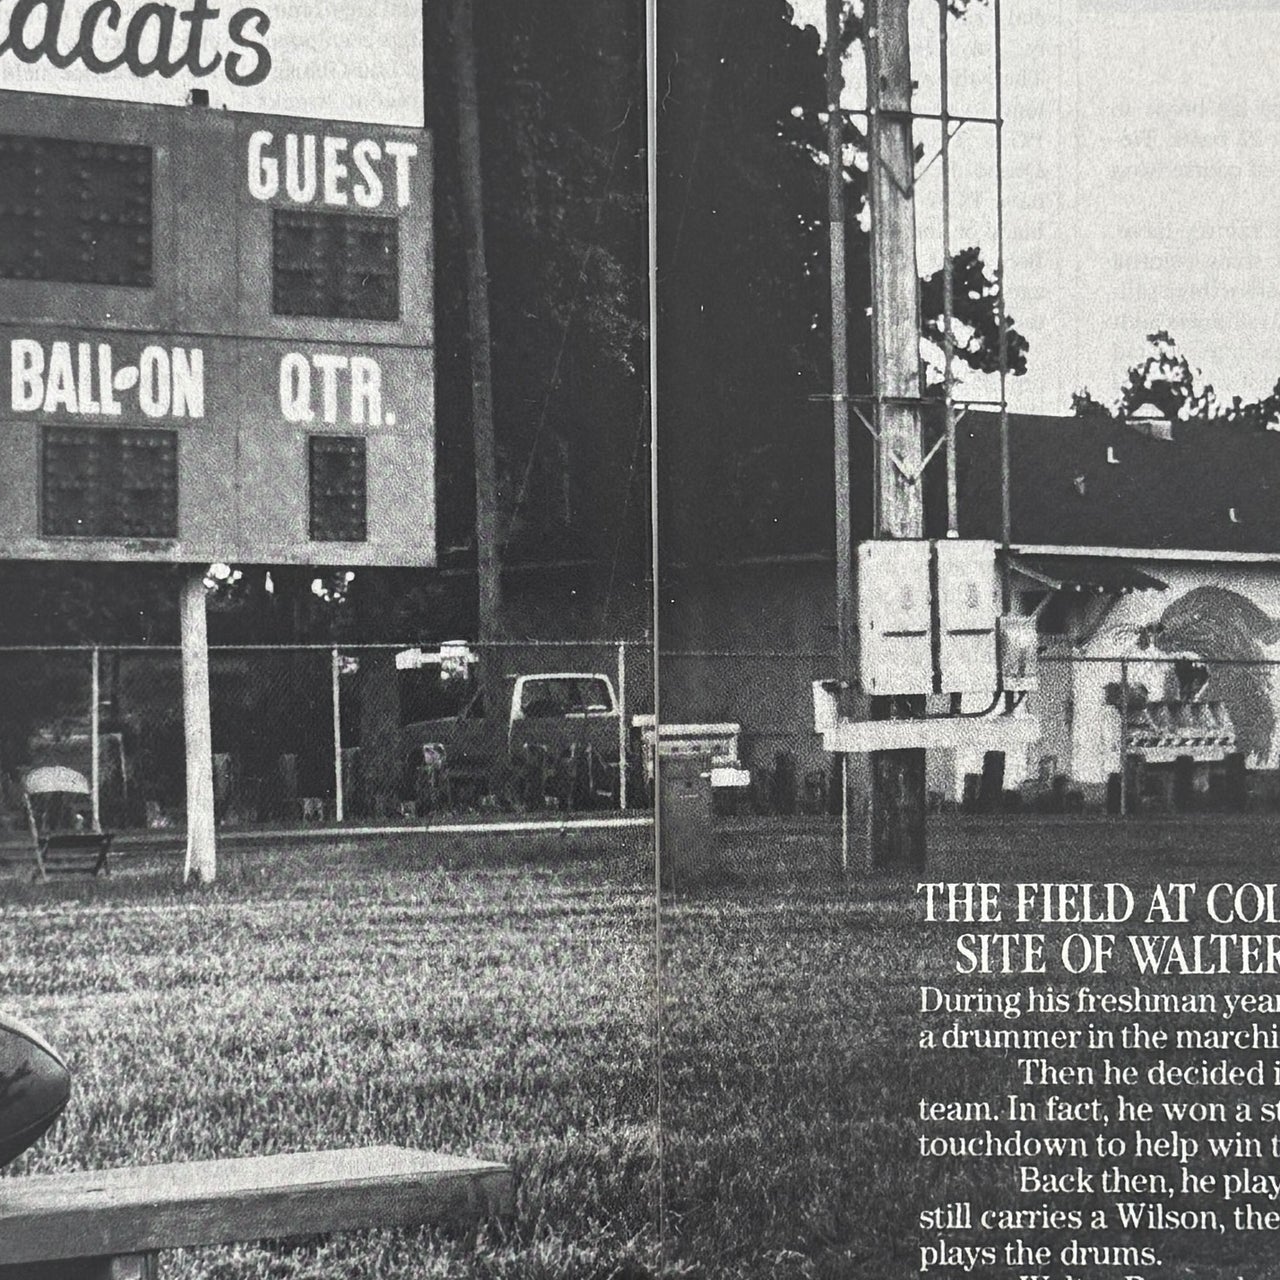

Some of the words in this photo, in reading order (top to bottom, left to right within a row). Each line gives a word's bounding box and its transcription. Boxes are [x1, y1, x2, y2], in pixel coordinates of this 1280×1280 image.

[249, 131, 417, 207] GUEST
[12, 339, 204, 418] BALL-ON
[280, 353, 395, 427] QTR.
[916, 882, 1001, 922] THE
[1016, 883, 1134, 922] FIELD
[1145, 883, 1196, 922] AT
[956, 934, 1046, 973] SITE
[1062, 934, 1115, 973] OF
[920, 986, 1021, 1019] During
[1027, 987, 1070, 1012] his
[1077, 987, 1216, 1012] freshman
[919, 1030, 936, 1048] a
[942, 1023, 1081, 1049] drummer
[1089, 1024, 1113, 1049] in
[1121, 1023, 1168, 1049] the
[1018, 1059, 1093, 1085] Then
[1104, 1059, 1138, 1085] he
[1148, 1060, 1264, 1085] decided
[918, 1130, 1088, 1157] touchdown
[1096, 1134, 1125, 1157] to
[1135, 1130, 1198, 1163] help
[1208, 1132, 1262, 1157] win
[1020, 1167, 1094, 1193] Back
[1102, 1166, 1174, 1198] then,
[1181, 1167, 1215, 1193] he
[920, 1202, 972, 1229] still
[981, 1204, 1082, 1229] carries
[1091, 1210, 1108, 1229] a
[1116, 1203, 1225, 1234] Wilson,
[1234, 1204, 1280, 1230] the
[920, 1239, 996, 1272] plays
[1005, 1239, 1051, 1265] the
[1061, 1240, 1162, 1266] drums.
